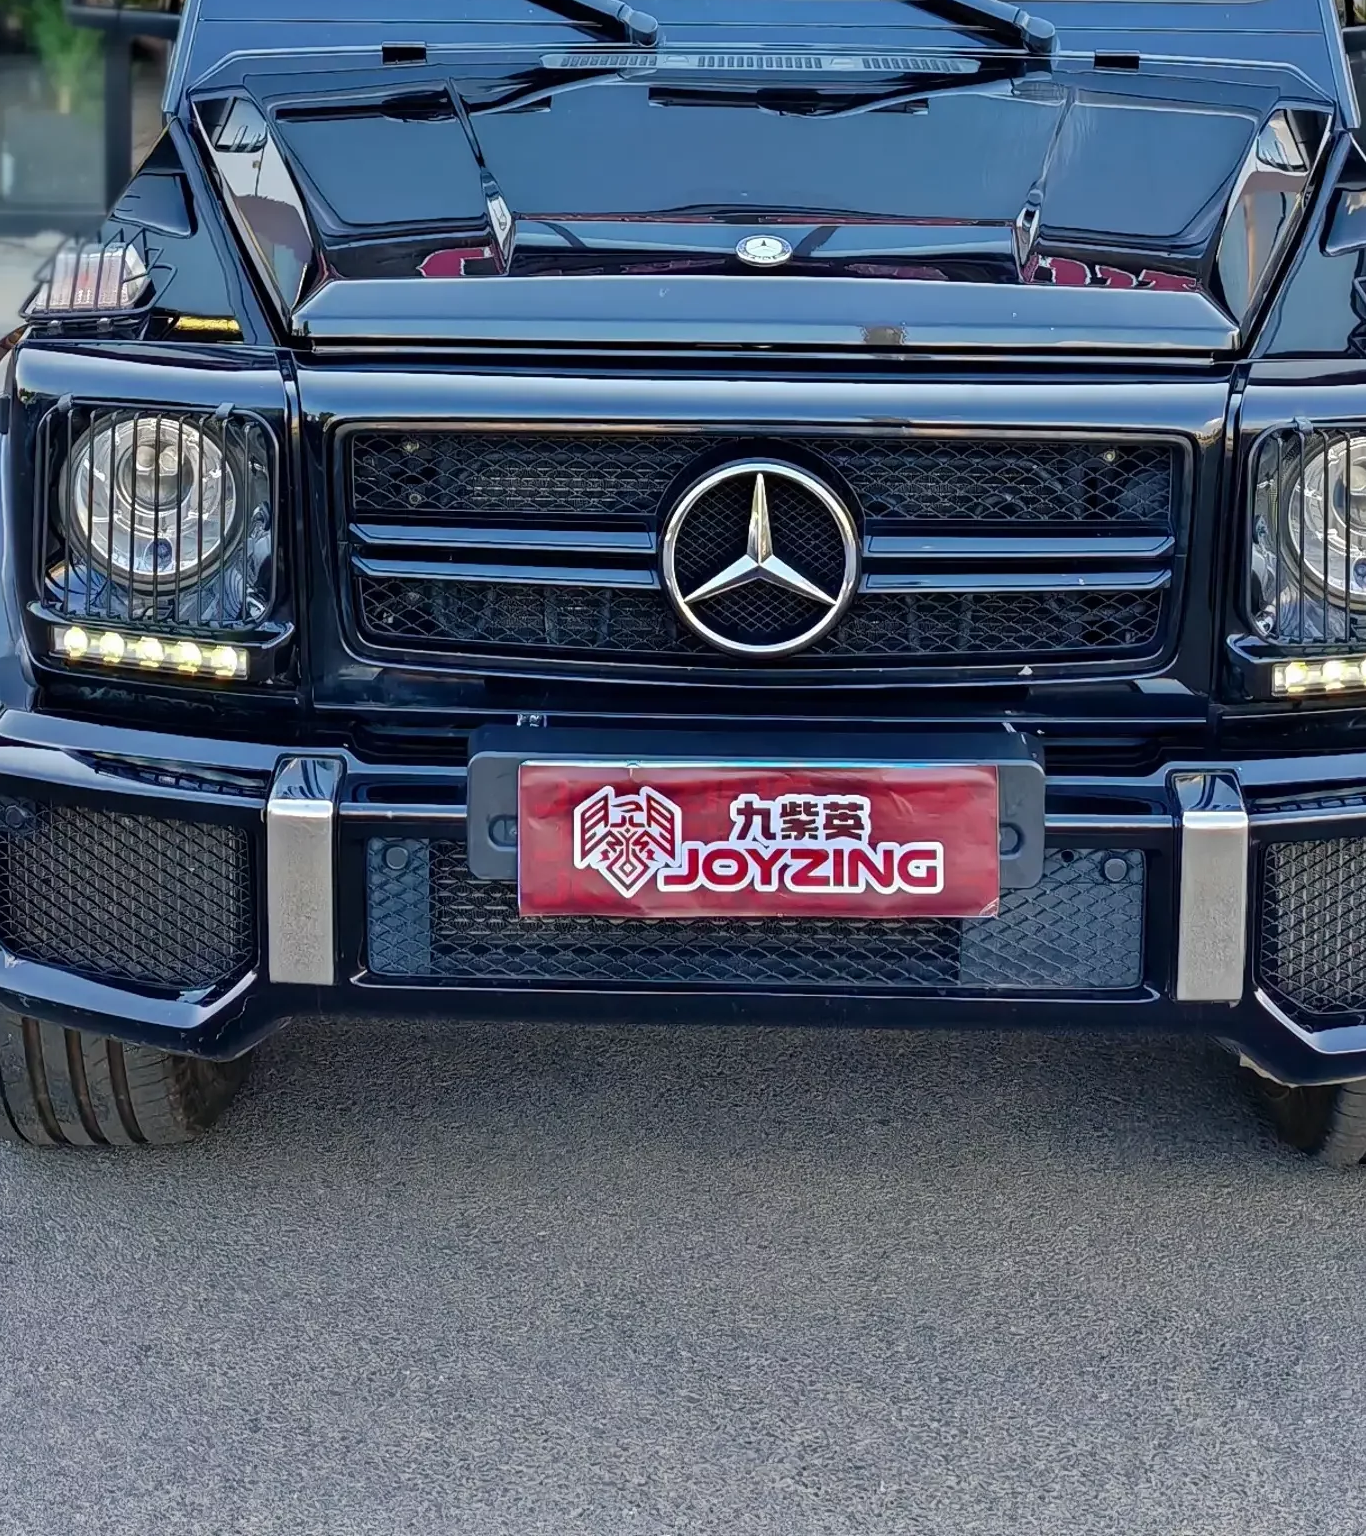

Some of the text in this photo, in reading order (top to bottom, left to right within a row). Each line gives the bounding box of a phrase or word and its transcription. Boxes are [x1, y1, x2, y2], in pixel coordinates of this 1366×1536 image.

[733, 797, 870, 841] 九紫英
[661, 846, 941, 890] JOYZING
